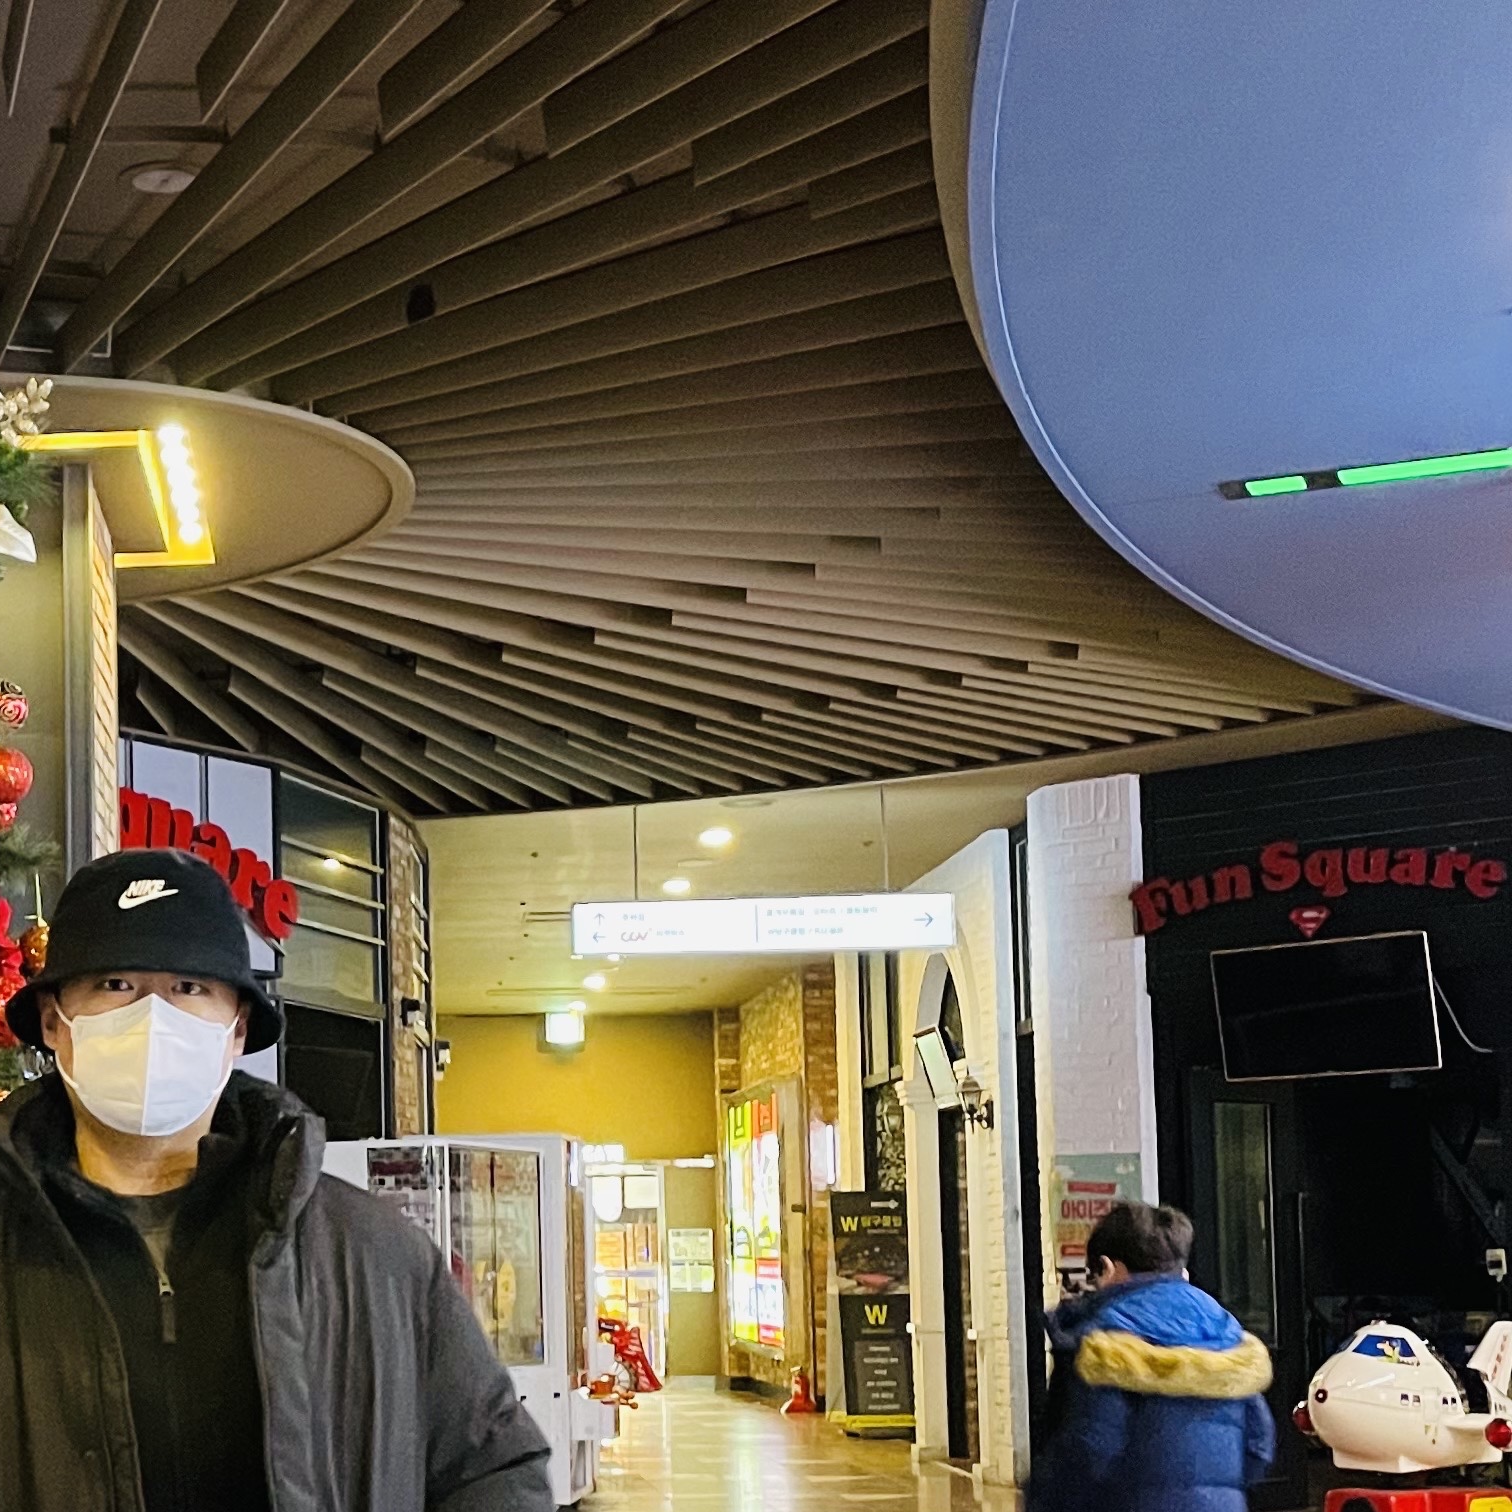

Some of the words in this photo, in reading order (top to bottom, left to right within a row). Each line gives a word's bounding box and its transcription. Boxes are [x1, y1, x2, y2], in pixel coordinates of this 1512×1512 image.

[127, 879, 166, 898] NIKE
[1129, 862, 1253, 935] Fun
[1259, 841, 1508, 898] Square
[864, 1304, 888, 1326] W
